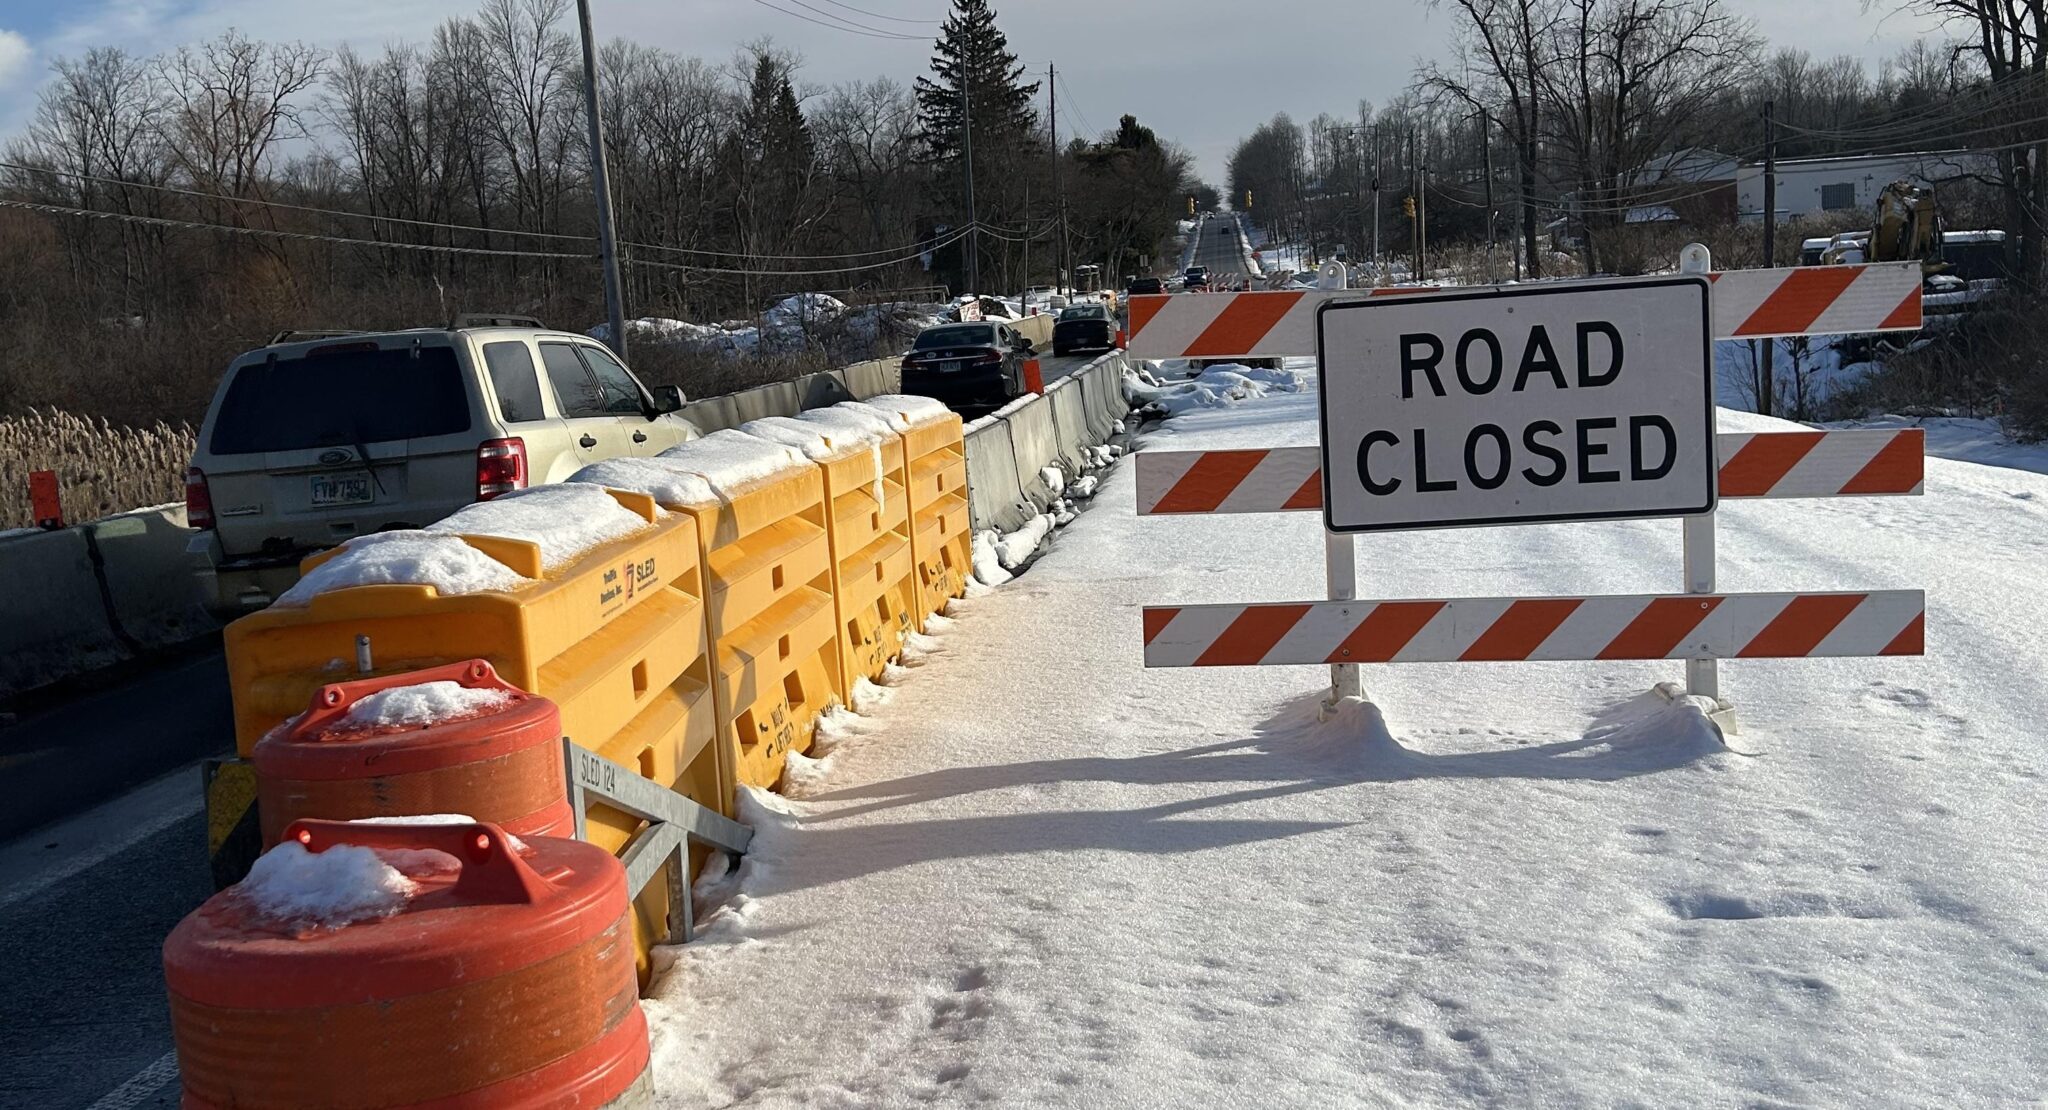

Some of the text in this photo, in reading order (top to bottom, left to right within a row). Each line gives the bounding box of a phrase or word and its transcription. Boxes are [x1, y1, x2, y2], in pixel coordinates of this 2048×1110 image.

[1399, 320, 1625, 399] ROAD
[1356, 414, 1678, 497] CLOSED
[636, 557, 655, 583] SLED
[581, 753, 615, 795] SLED 124
